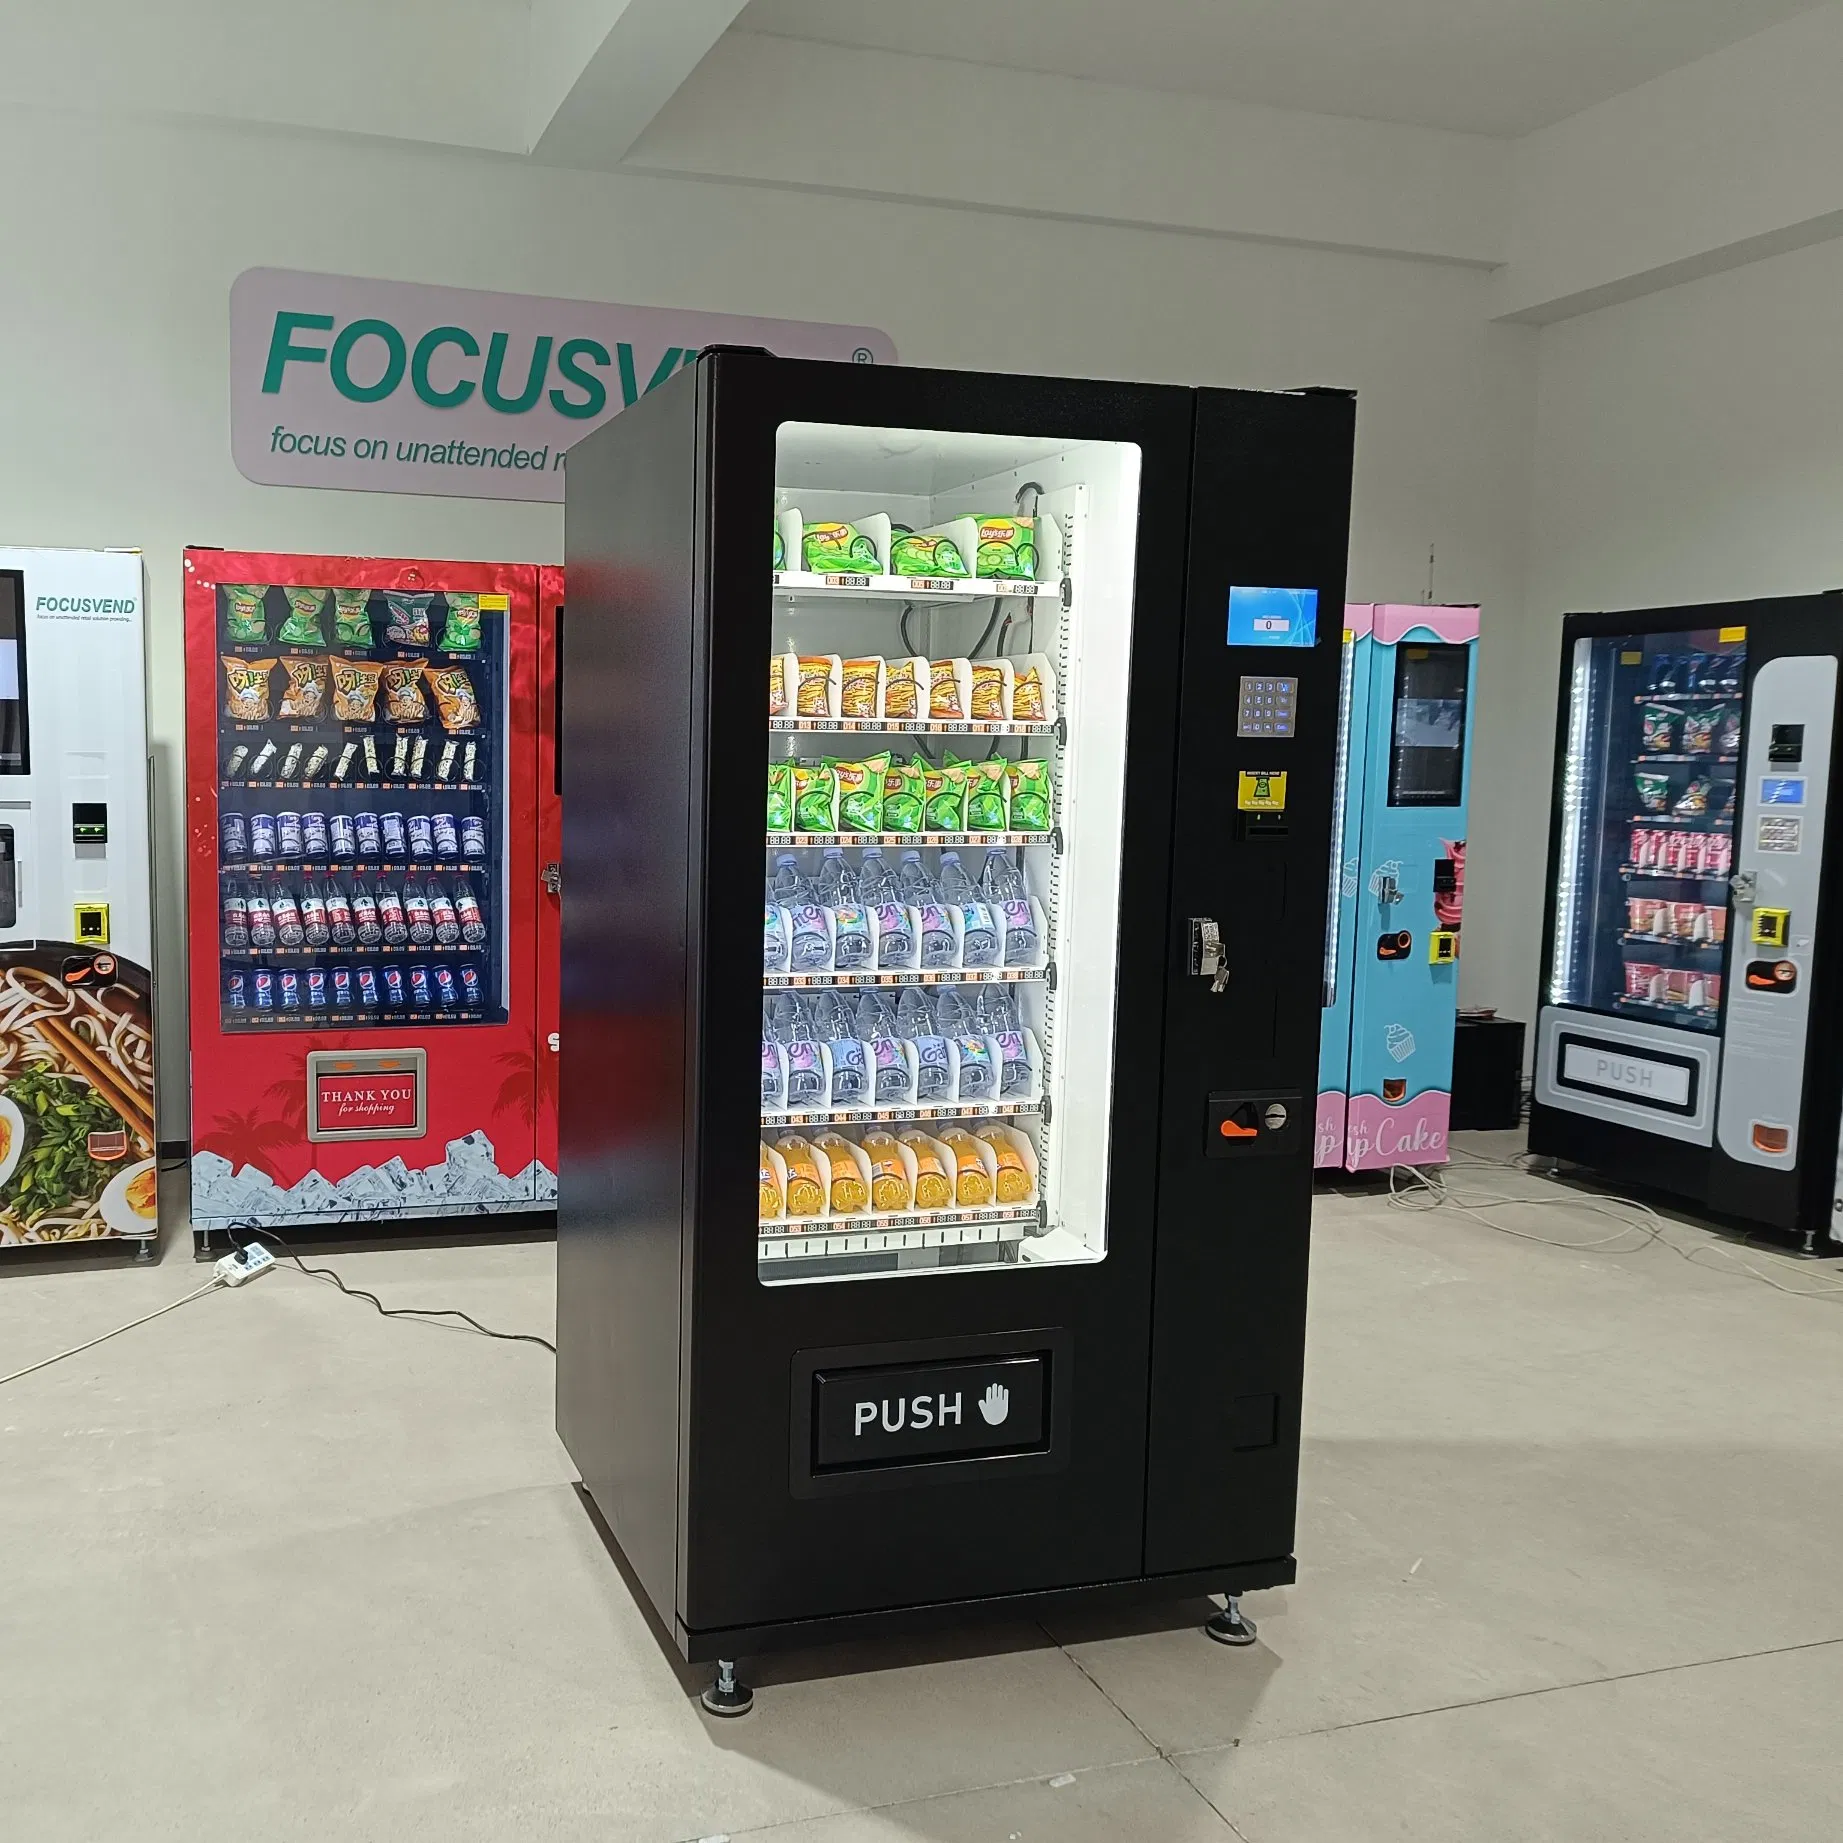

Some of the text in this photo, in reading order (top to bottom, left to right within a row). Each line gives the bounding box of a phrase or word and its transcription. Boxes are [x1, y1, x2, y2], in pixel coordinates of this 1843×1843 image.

[261, 311, 699, 419] FOCUSV
[270, 426, 346, 457] focus
[353, 438, 388, 460] on
[396, 440, 548, 471] unattended
[36, 596, 135, 614] FOCUSVEND
[800, 722, 812, 730] 013
[1596, 1059, 1655, 1088] PUSH
[321, 1088, 411, 1102] THANK YOU
[338, 1101, 395, 1117] for shopping
[855, 1392, 962, 1436] PUSH
